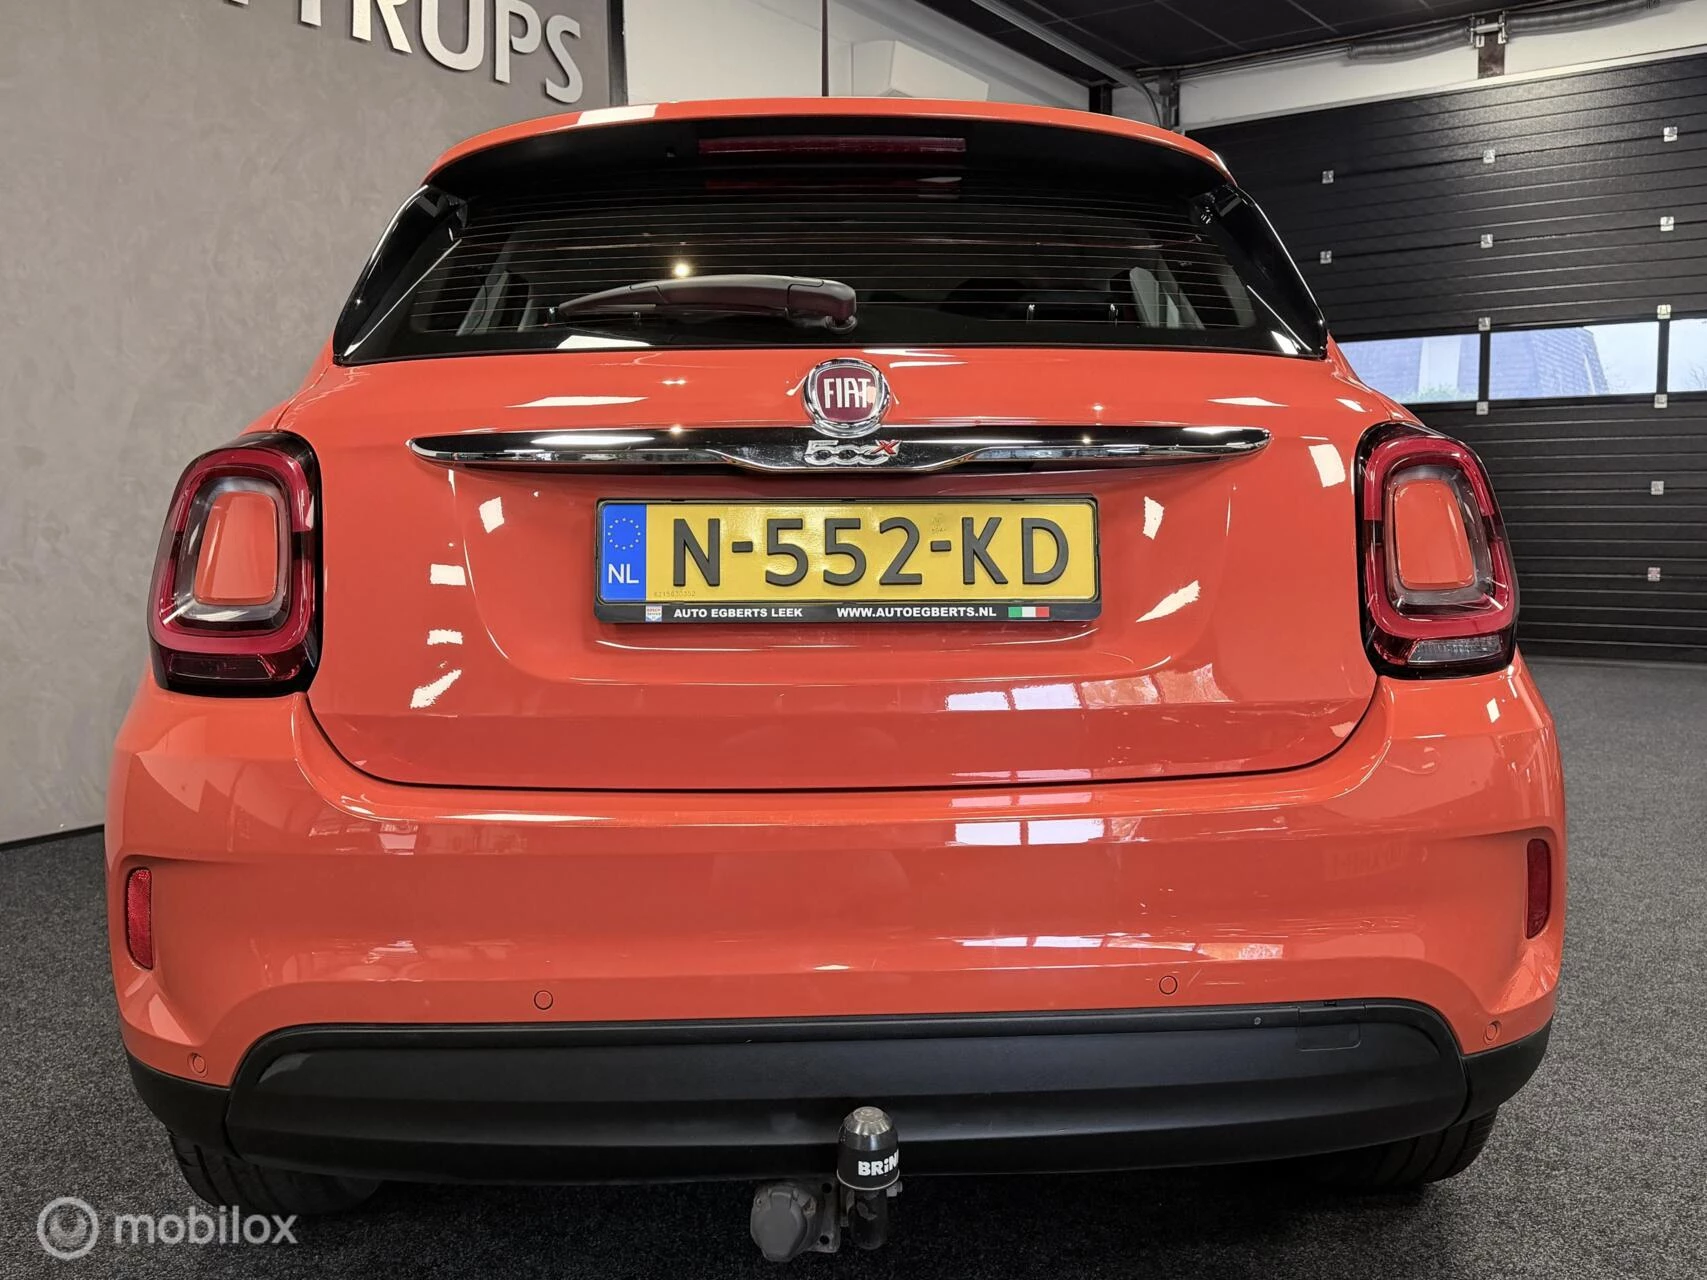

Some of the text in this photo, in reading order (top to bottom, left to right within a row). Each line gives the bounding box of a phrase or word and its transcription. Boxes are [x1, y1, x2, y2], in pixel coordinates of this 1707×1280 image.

[823, 377, 871, 408] FIAT
[672, 516, 1070, 587] N-552-KD
[608, 563, 640, 584] NL
[673, 608, 803, 618] AUTO EGBERTS LEEK
[836, 606, 997, 618] WWW.AUTOEGBERTS.NL
